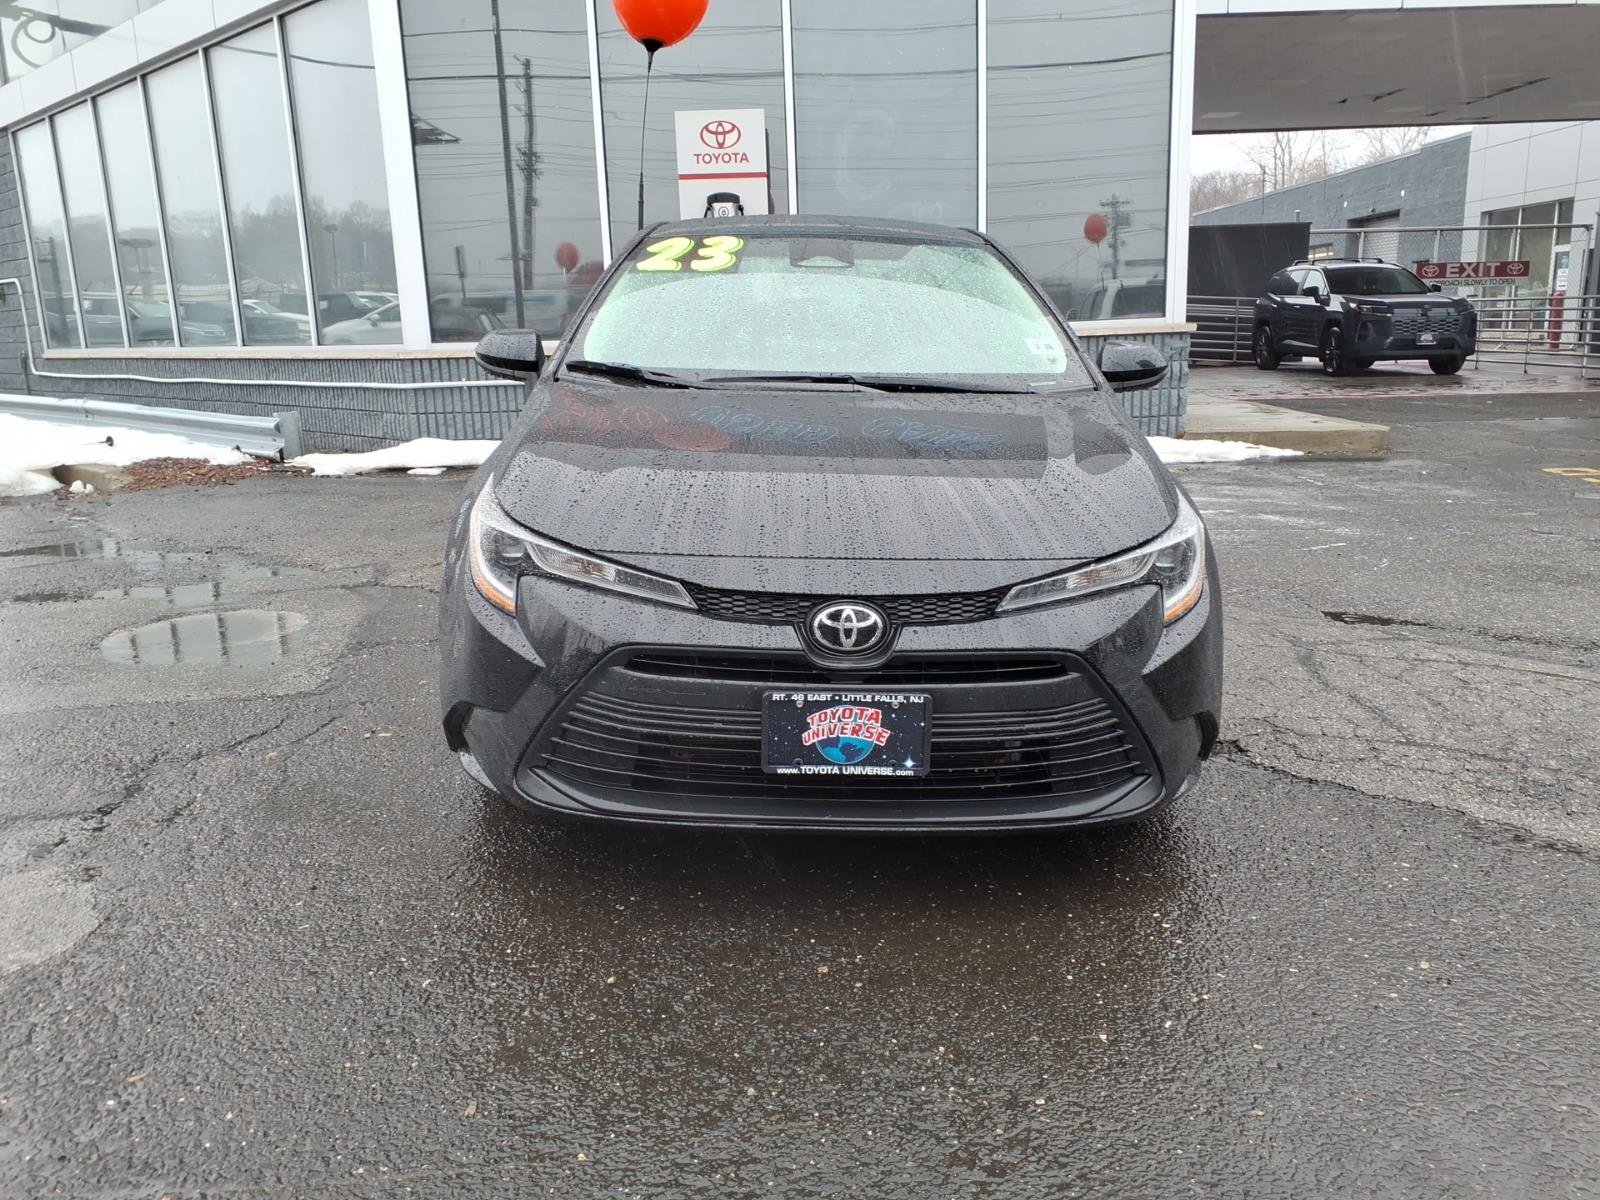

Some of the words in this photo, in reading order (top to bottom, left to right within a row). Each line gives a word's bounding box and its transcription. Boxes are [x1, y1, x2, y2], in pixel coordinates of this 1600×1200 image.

[693, 152, 749, 165] TOYOTA
[636, 235, 744, 272] 23
[1445, 262, 1500, 278] EXIT
[1464, 279, 1487, 287] SLOWLY
[1488, 278, 1498, 286] TO
[1499, 277, 1516, 286] OPEN
[842, 694, 872, 702] LITTLE
[875, 695, 907, 704] FALLS,
[807, 706, 882, 727] TOYOTA
[802, 722, 891, 745] UNIVERSE
